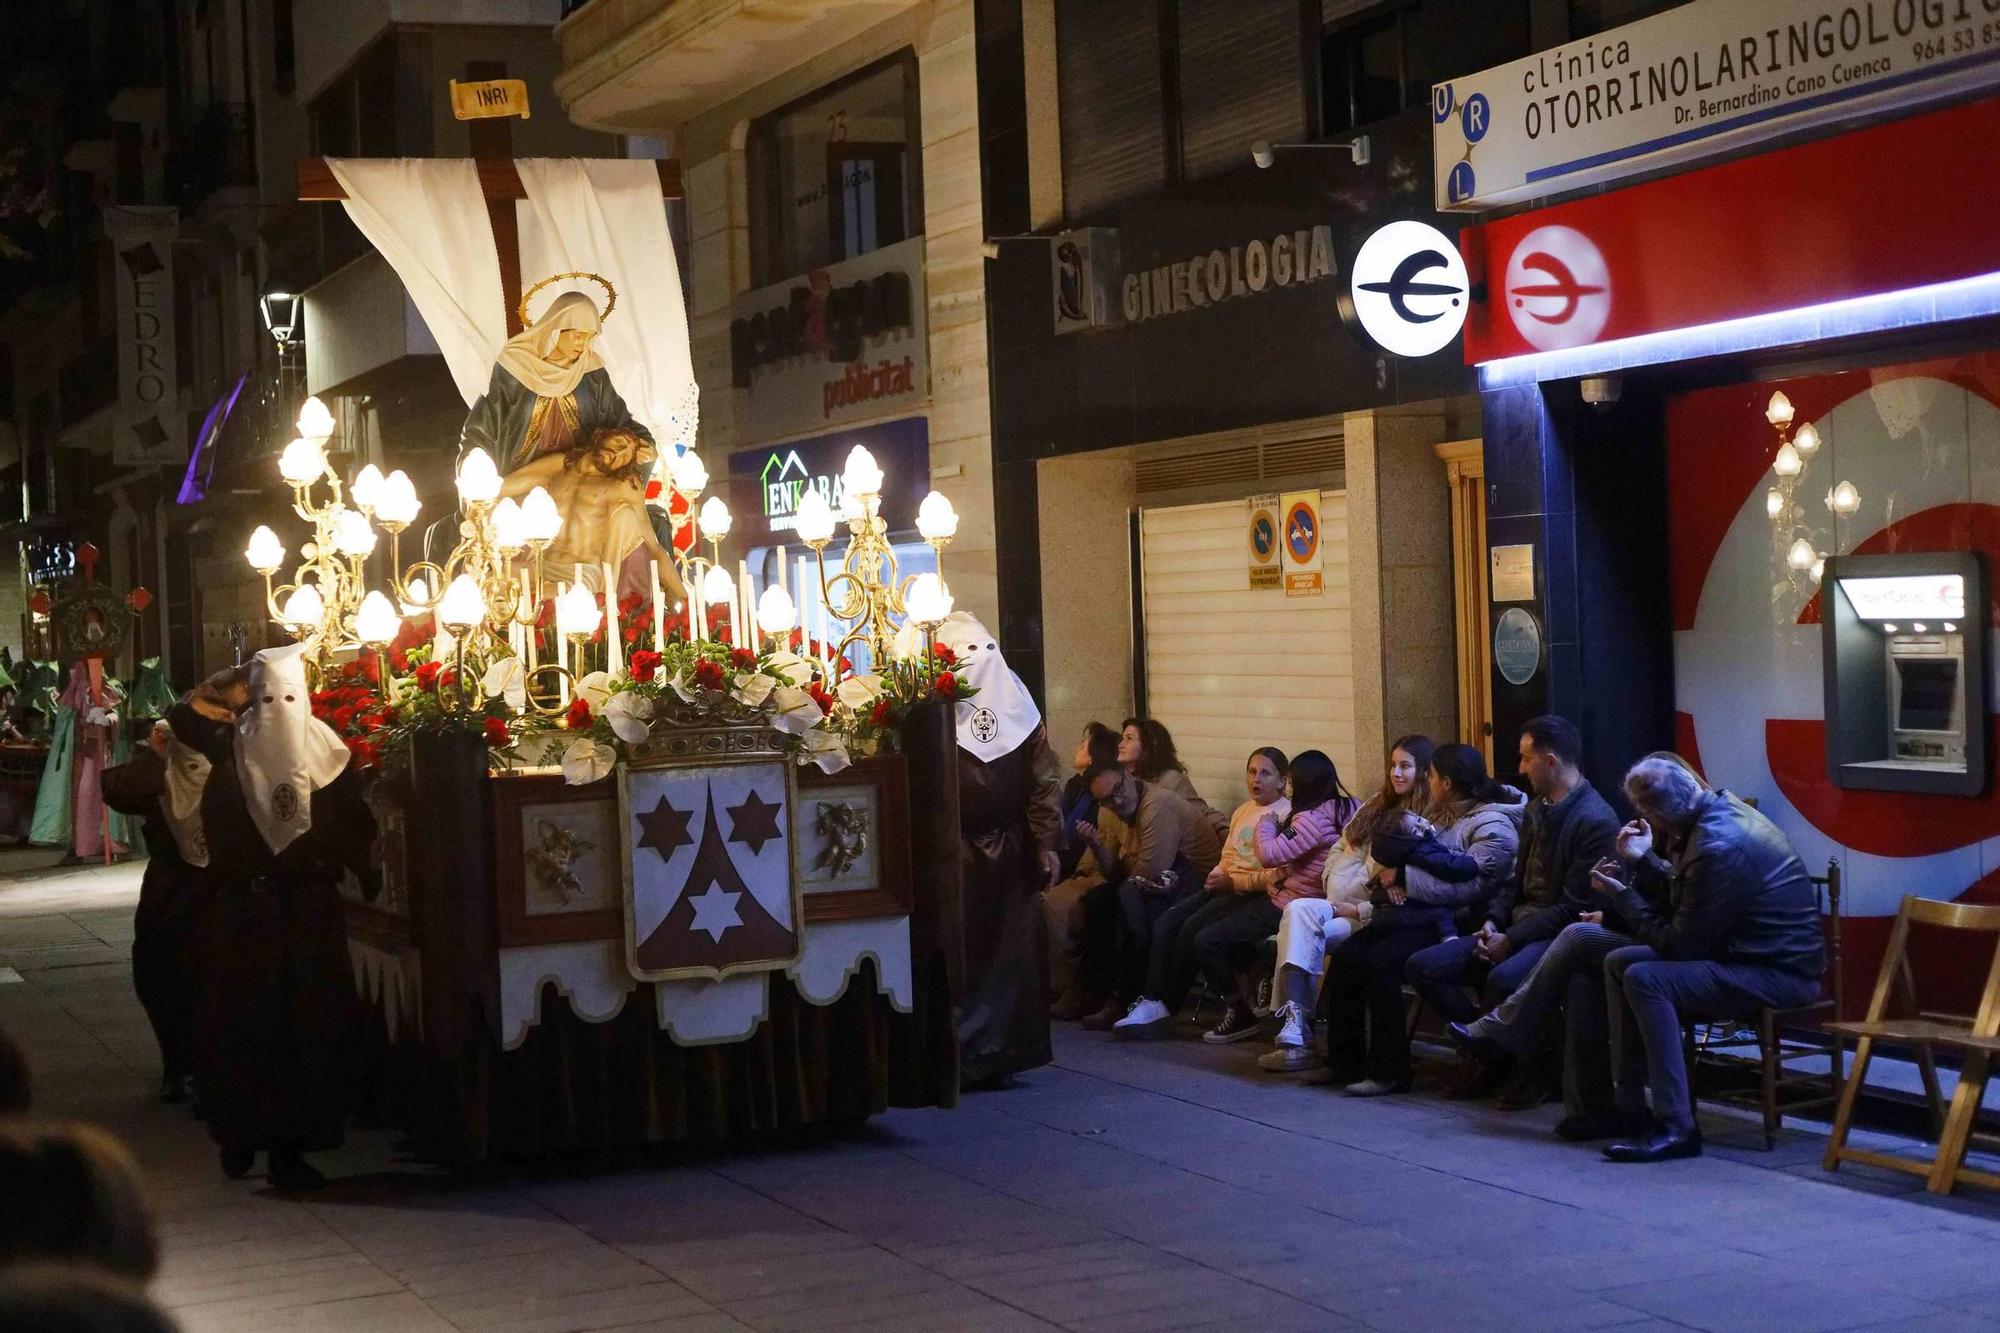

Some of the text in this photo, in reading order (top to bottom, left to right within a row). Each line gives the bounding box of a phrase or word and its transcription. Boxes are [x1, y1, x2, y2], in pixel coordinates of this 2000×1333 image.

[476, 87, 509, 106] INRI
[1524, 41, 1630, 93] clínica
[1525, 0, 2000, 139] OTORRINOLARINGOLOG
[1674, 105, 1694, 124] Dr.
[1700, 85, 1781, 118] Bernardino
[1786, 75, 1826, 96] Cano
[1832, 56, 1892, 85] Cuenca
[1913, 37, 1945, 63] 964
[1953, 28, 1975, 52] 53
[1123, 225, 1336, 321] GINECOLOGIA
